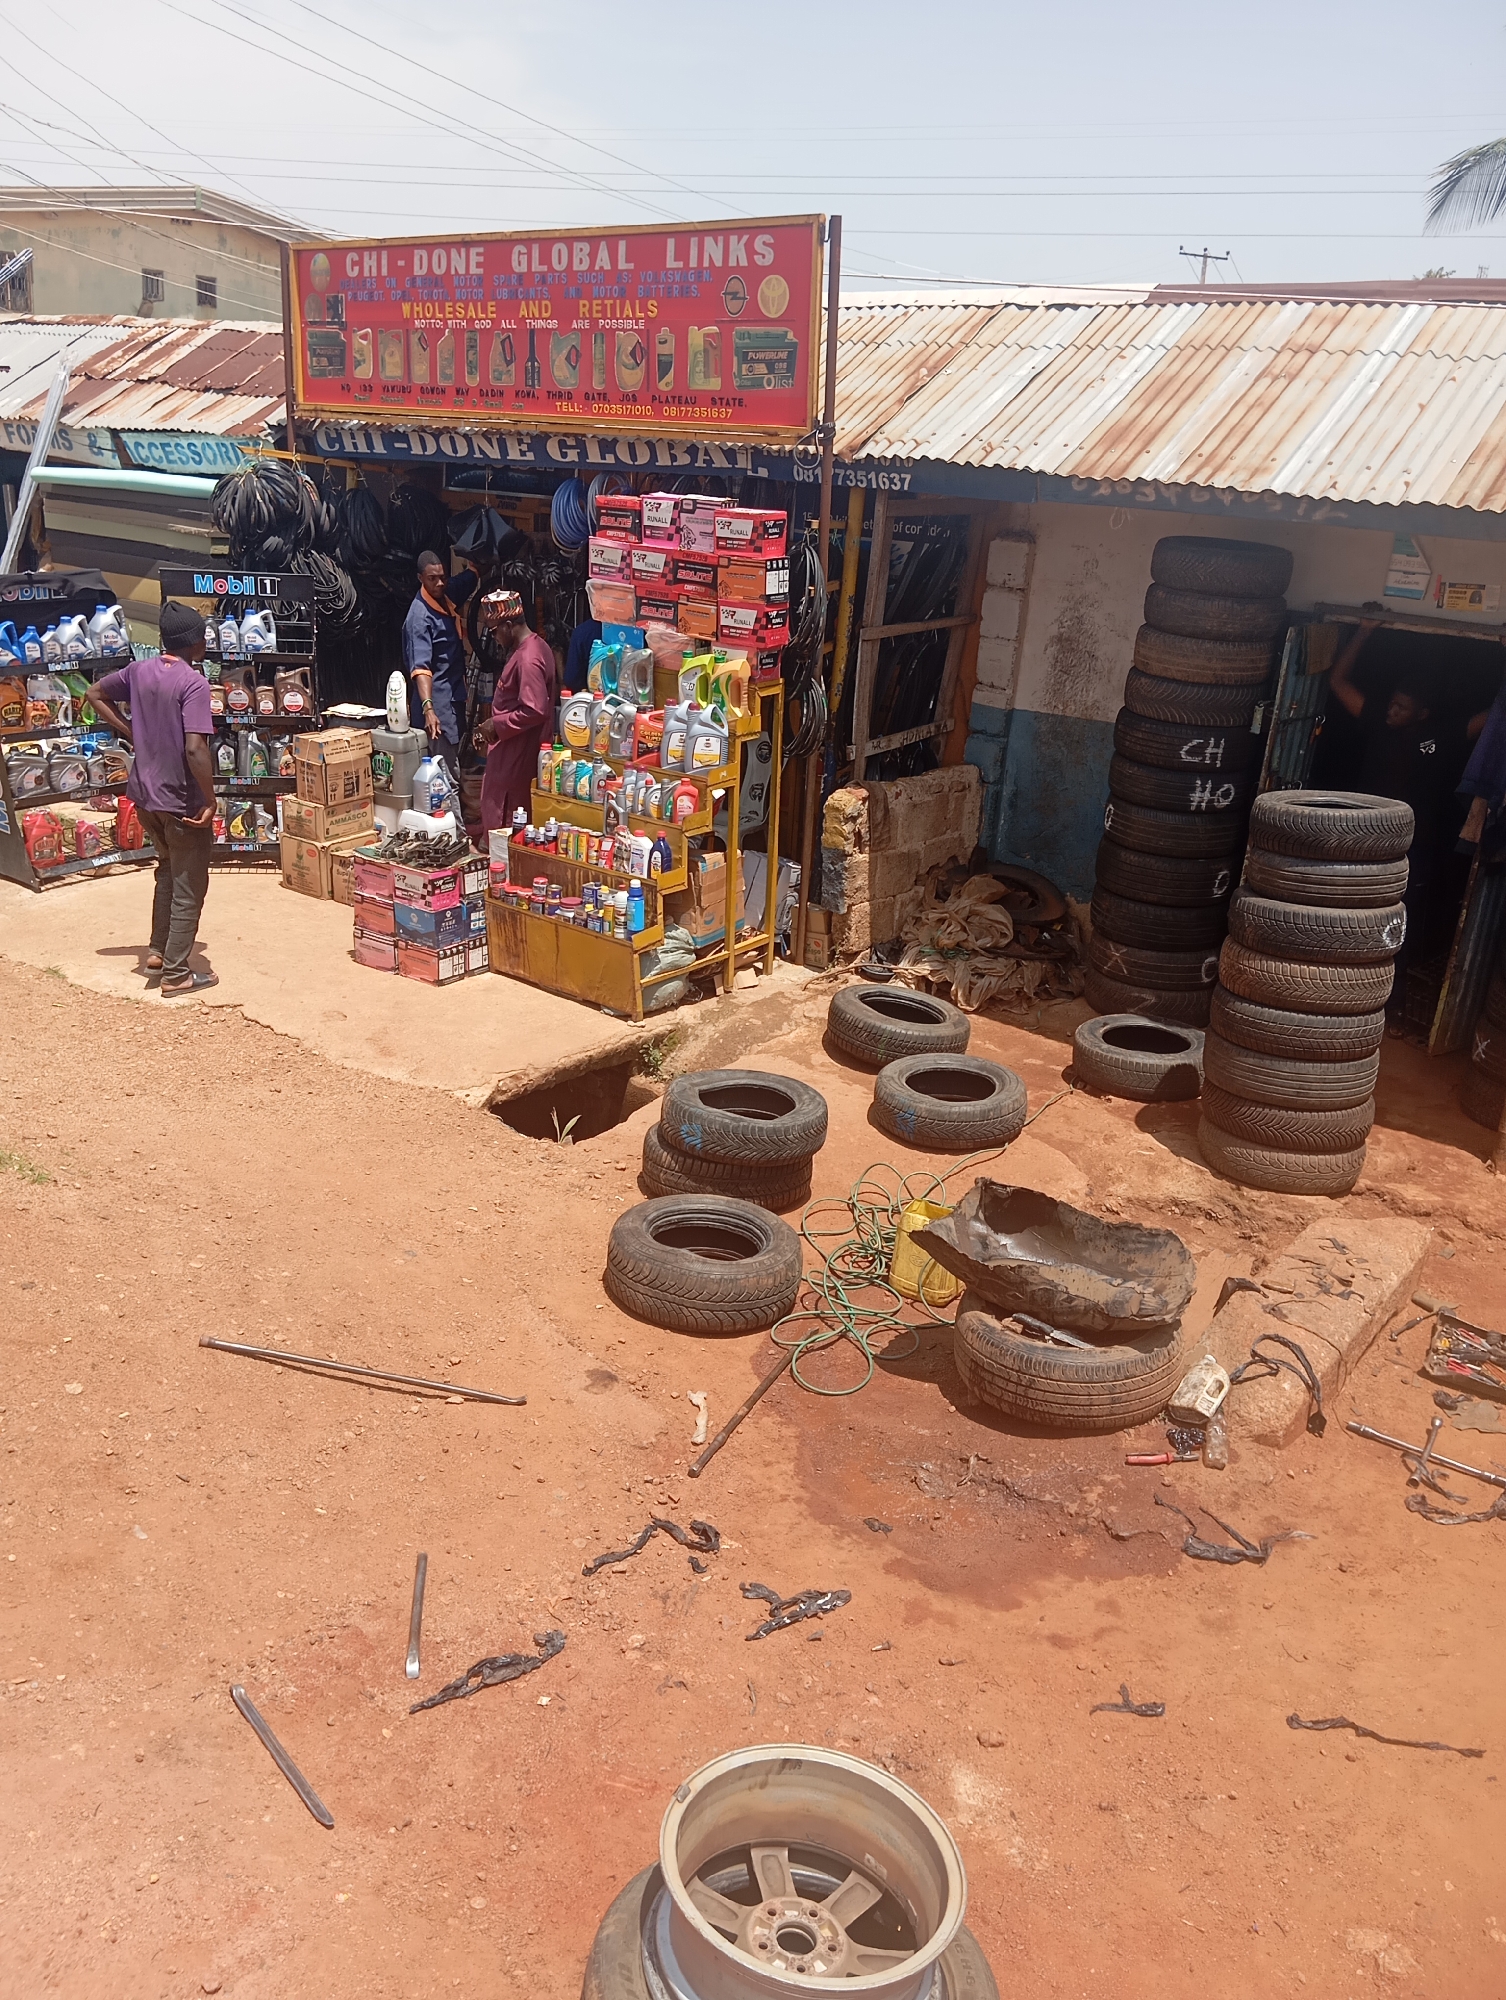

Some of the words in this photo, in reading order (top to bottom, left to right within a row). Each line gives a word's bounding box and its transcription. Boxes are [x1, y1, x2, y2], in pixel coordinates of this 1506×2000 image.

[511, 240, 634, 273] GLOBAL
[666, 234, 775, 268] LINKS
[340, 278, 376, 290] DEALERS
[386, 277, 396, 289] ON
[405, 276, 444, 288] GENERAL
[493, 274, 524, 286] SPARE
[534, 273, 568, 285] PARTS
[577, 272, 604, 284] SUCH
[564, 286, 582, 298] AND
[402, 301, 497, 319] WHOLESALE
[519, 300, 552, 318] AND
[579, 300, 658, 318] RETIALS
[448, 320, 467, 329] WITH
[474, 319, 492, 329] GOD
[500, 319, 517, 329] ALL
[525, 319, 559, 329] THINGS
[572, 319, 590, 330] ARE
[598, 319, 645, 330] POSSIBLE
[456, 386, 470, 397] WAY
[480, 388, 505, 398] DADIN
[546, 390, 573, 400] THRID
[619, 392, 638, 403] JOS
[651, 394, 698, 406] PLATEAU
[556, 402, 584, 413] TELL:
[662, 406, 733, 418] 08177351637
[87, 432, 104, 458] &
[546, 437, 768, 477] GLOBAL
[793, 464, 912, 491] 0817351637
[600, 516, 632, 528] SOLITE
[646, 515, 668, 524] RUNALL
[730, 528, 749, 537] RUNALL
[602, 557, 619, 566] RUNALL
[644, 561, 661, 571] RUNALL
[678, 570, 714, 582] SOLITE
[194, 574, 255, 596] Mobil
[640, 606, 675, 619] SOLITE
[733, 618, 752, 627] RUNALL
[48, 662, 71, 671] Mobil
[60, 728, 81, 736] Mobil
[329, 811, 367, 826] AMMASCO
[92, 856, 113, 866] Mobil
